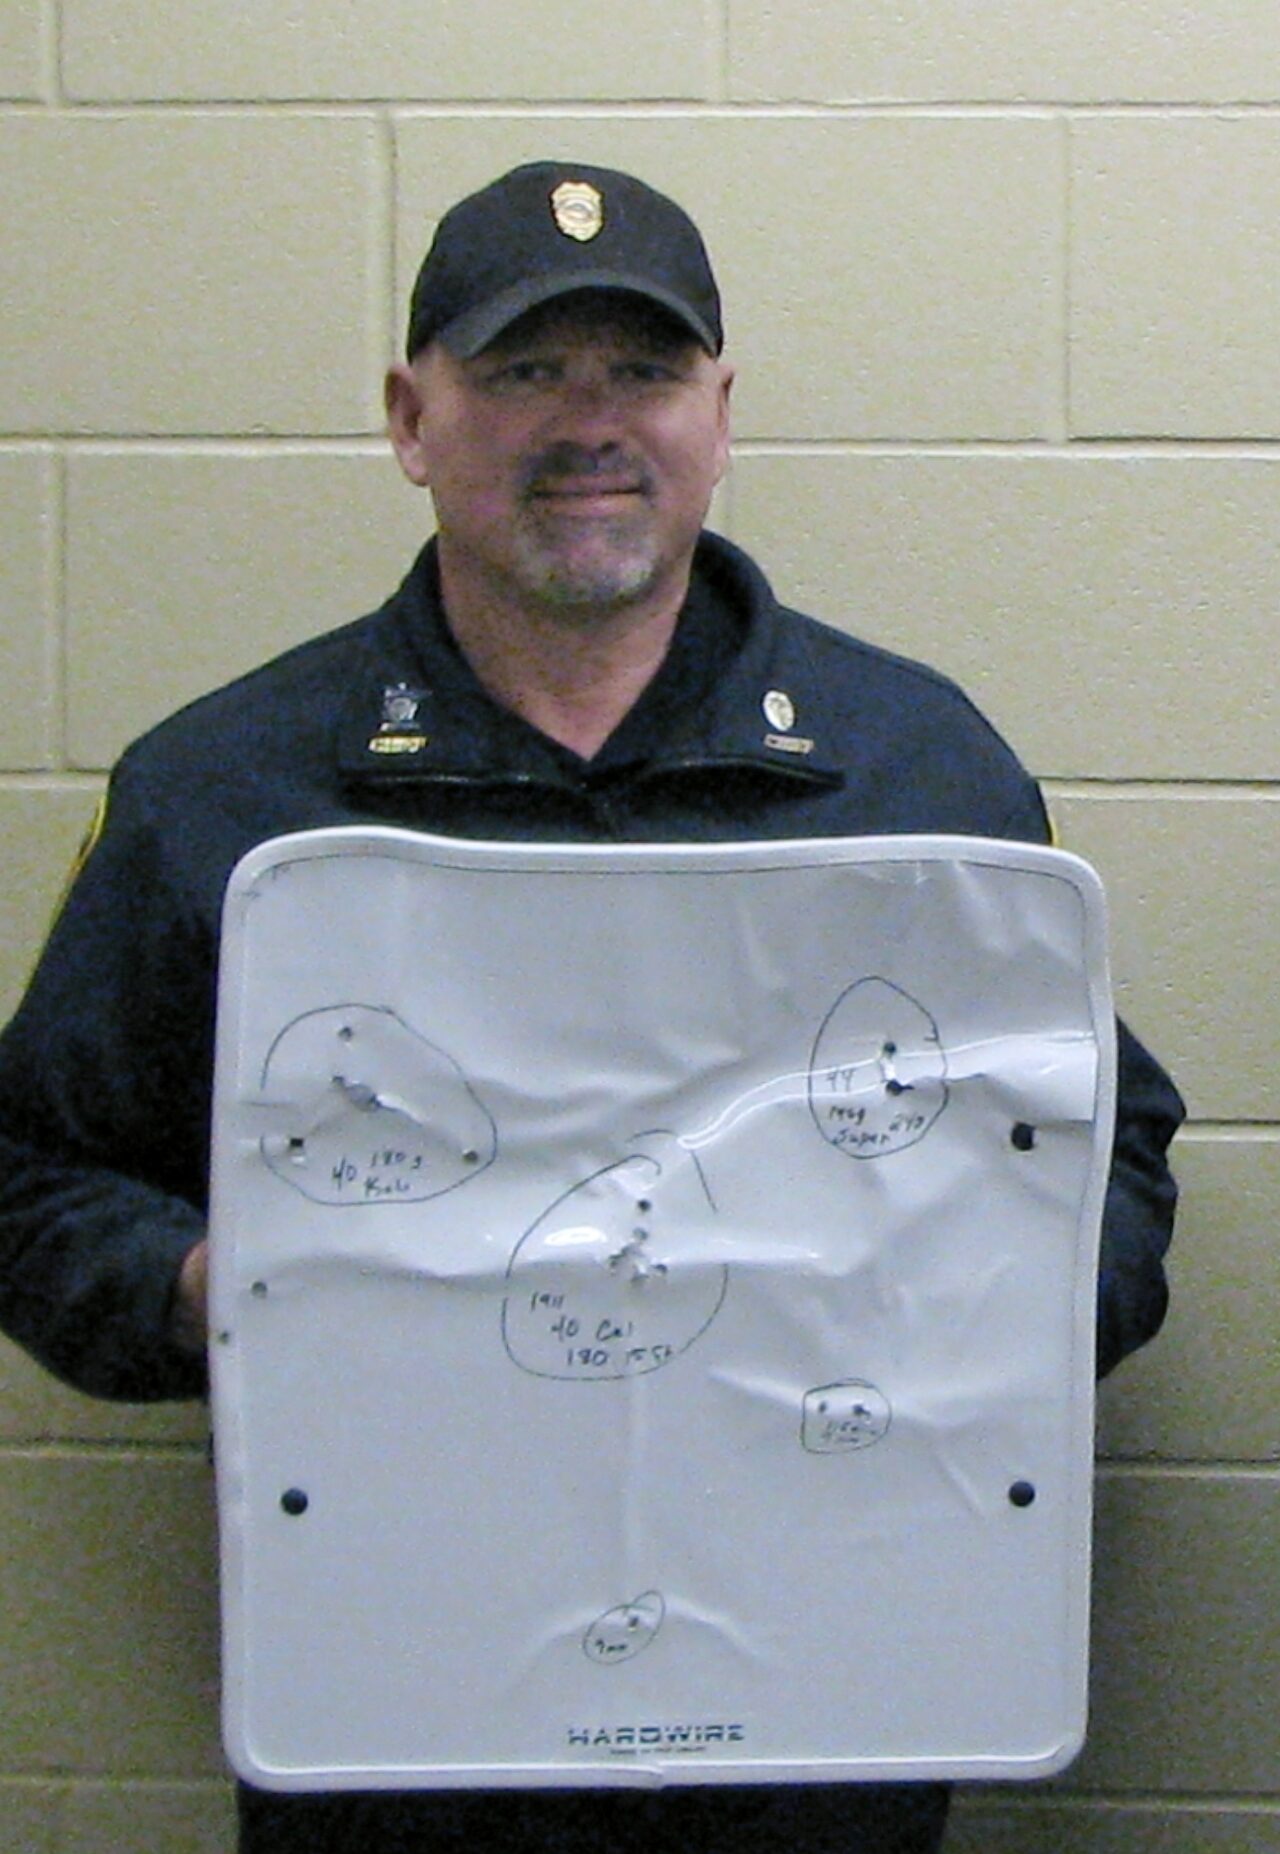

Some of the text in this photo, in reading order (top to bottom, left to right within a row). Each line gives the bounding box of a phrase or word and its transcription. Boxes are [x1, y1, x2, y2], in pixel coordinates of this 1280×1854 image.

[551, 1314, 580, 1342] 40
[567, 1348, 609, 1367] 180
[568, 1725, 744, 1746] HARDWIRE
